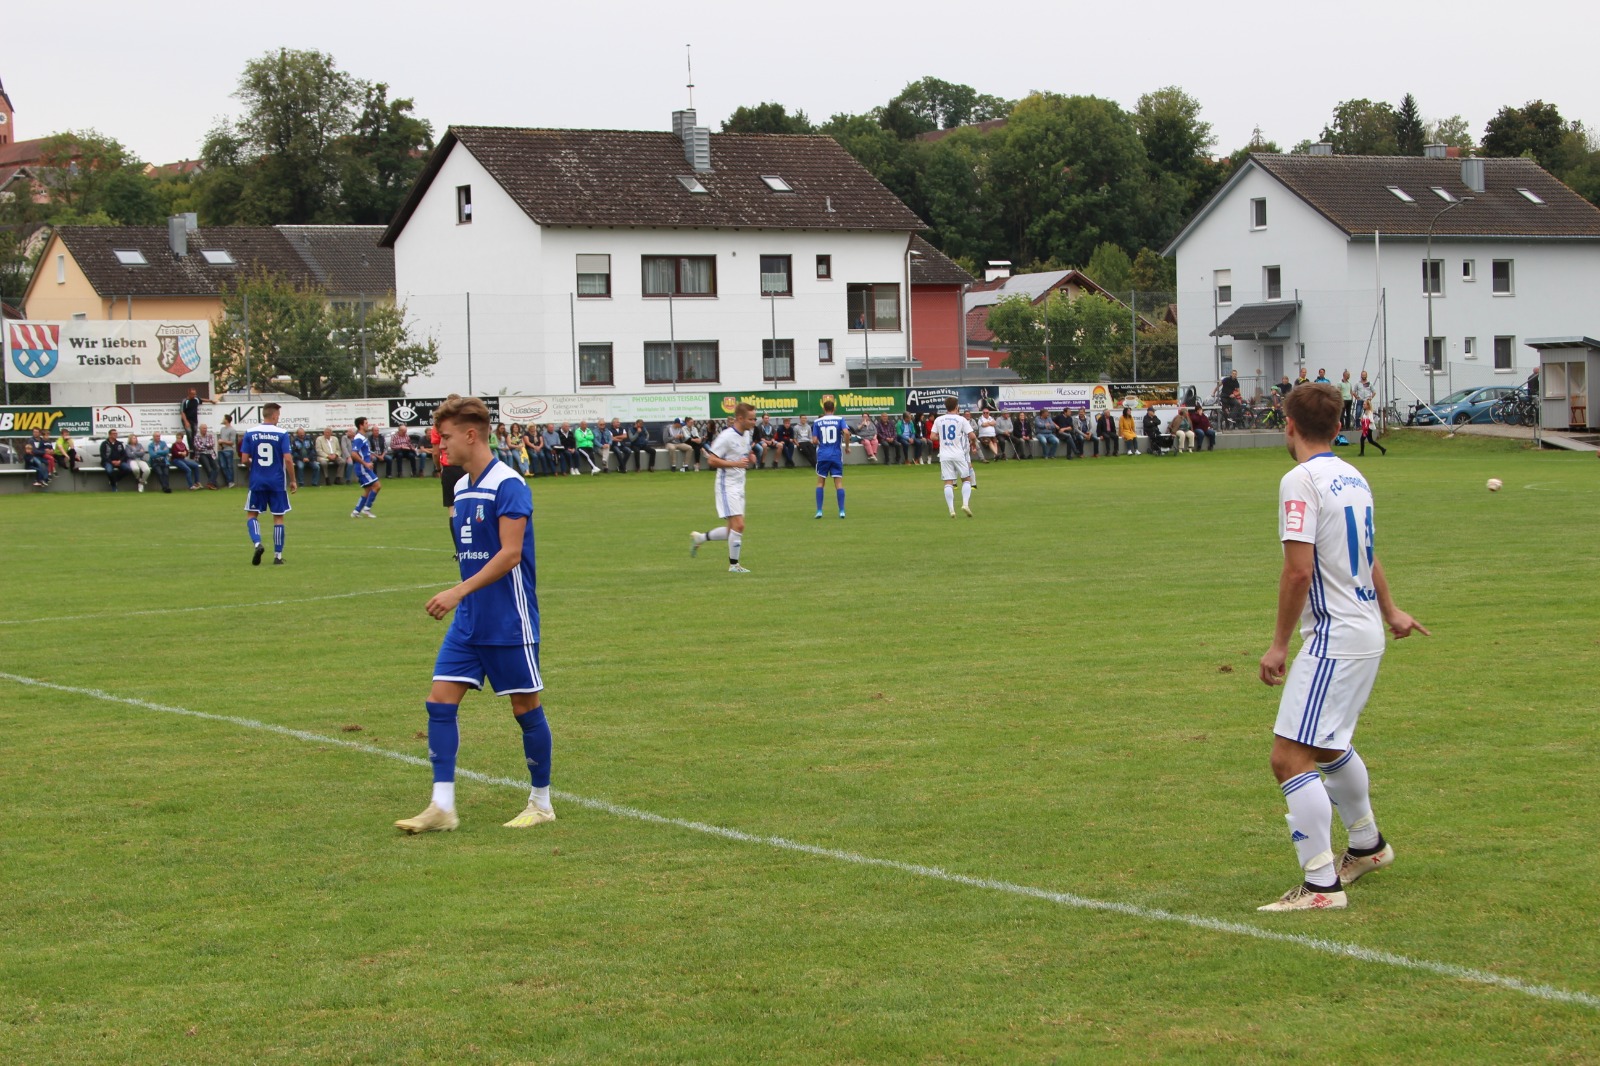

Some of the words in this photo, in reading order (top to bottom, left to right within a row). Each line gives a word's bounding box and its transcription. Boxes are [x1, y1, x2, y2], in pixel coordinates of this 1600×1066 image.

[69, 337, 98, 349] Wir
[102, 337, 147, 349] lieben
[76, 354, 142, 366] Teisbach
[918, 388, 959, 397] PrimaVital
[1056, 387, 1087, 396] Messerer
[740, 395, 799, 409] Wittmann
[838, 393, 895, 407] Wittmann
[0, 410, 63, 431] BWAY
[251, 433, 259, 442] FC
[258, 433, 279, 442] Teisbach
[820, 425, 837, 444] 10
[942, 424, 956, 441] 18
[257, 442, 274, 467] 9
[1329, 479, 1343, 497] FC
